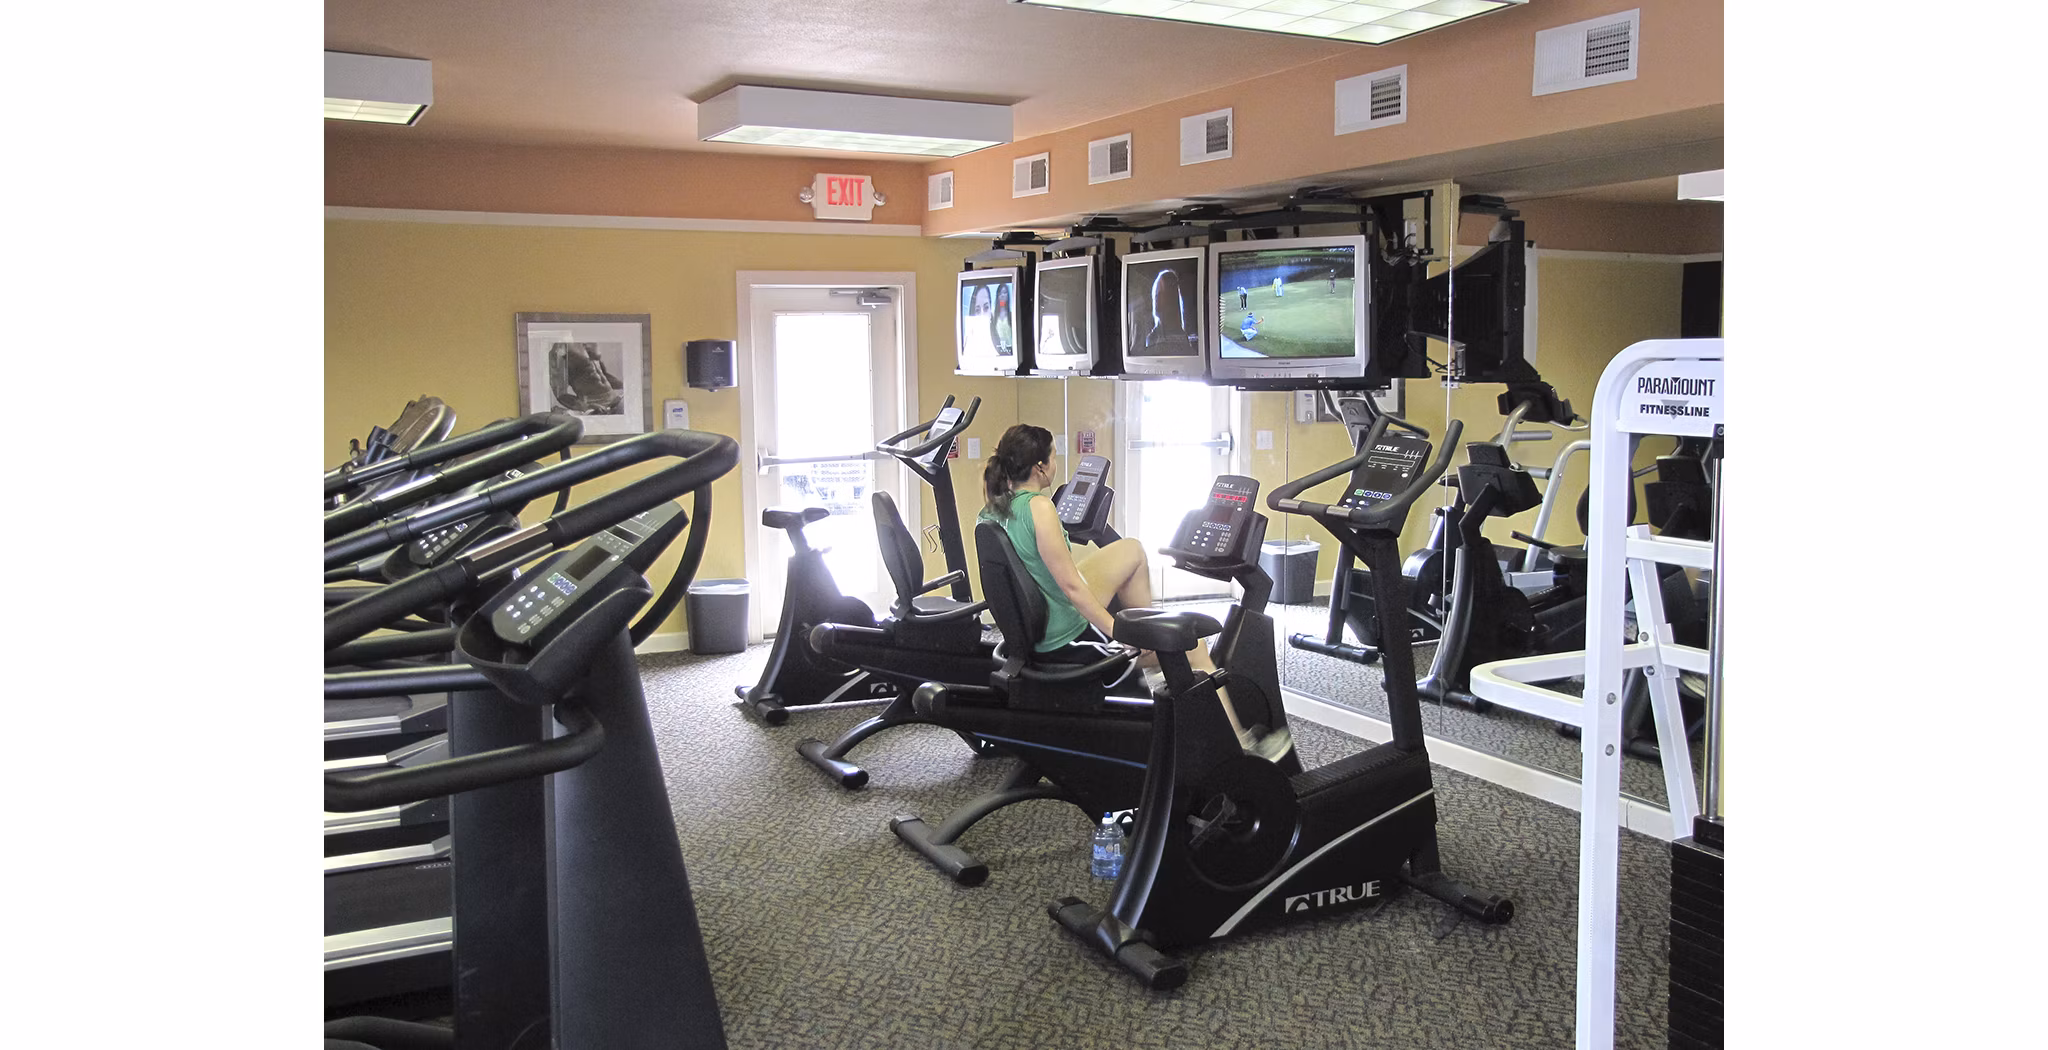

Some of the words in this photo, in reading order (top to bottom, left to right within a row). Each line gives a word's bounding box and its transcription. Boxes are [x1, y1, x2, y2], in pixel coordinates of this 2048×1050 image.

[826, 176, 865, 206] EXIT
[1637, 377, 1716, 397] PARAMOUNT
[1640, 404, 1710, 417] FITNESSLINE
[1311, 880, 1381, 907] TRUE
